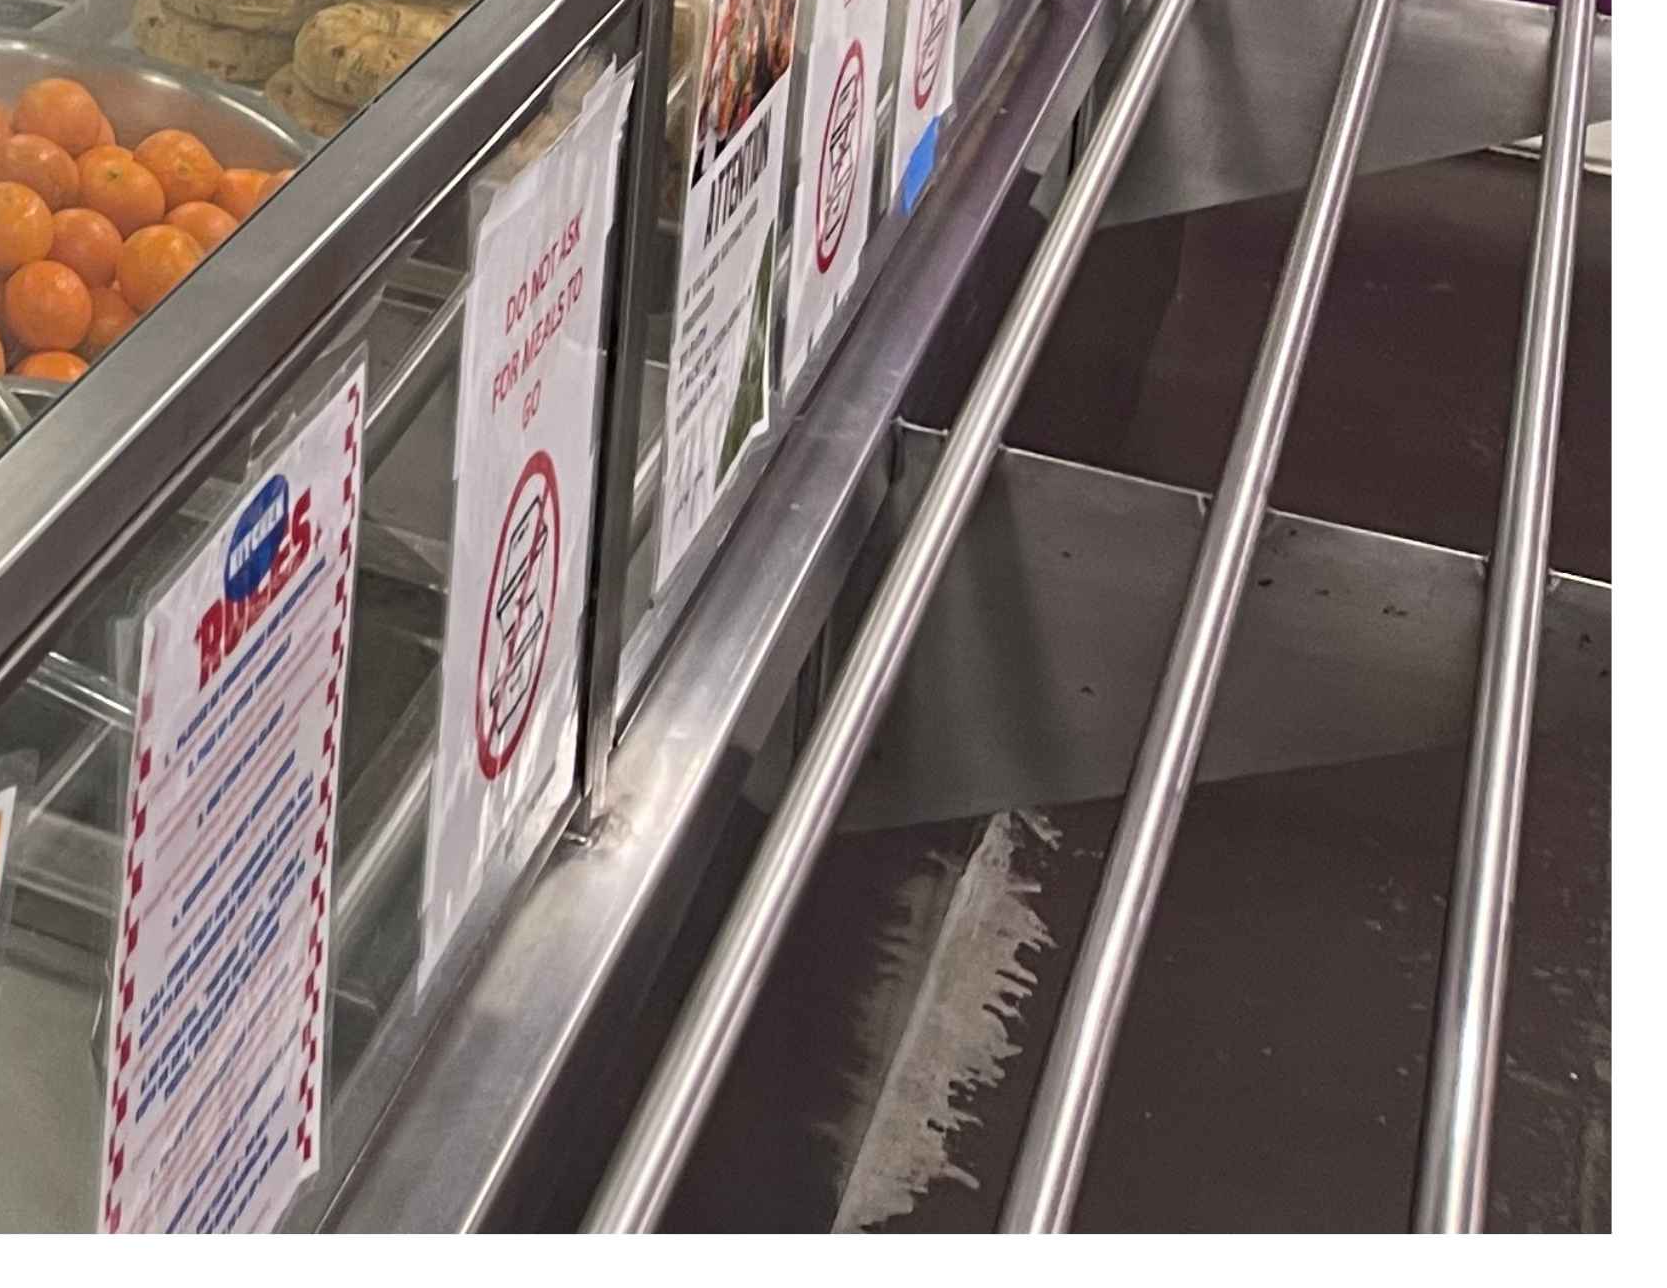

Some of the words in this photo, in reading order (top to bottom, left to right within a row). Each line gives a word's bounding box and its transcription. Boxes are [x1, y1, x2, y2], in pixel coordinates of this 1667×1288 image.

[702, 106, 772, 250] ATTENTION
[491, 349, 521, 417] FOR
[521, 290, 566, 377] MEALS
[566, 266, 584, 313] TO
[504, 281, 528, 336] DO
[529, 241, 559, 307] NOT
[559, 208, 584, 264] ASK
[522, 379, 541, 431] GO
[198, 486, 313, 691] RULES
